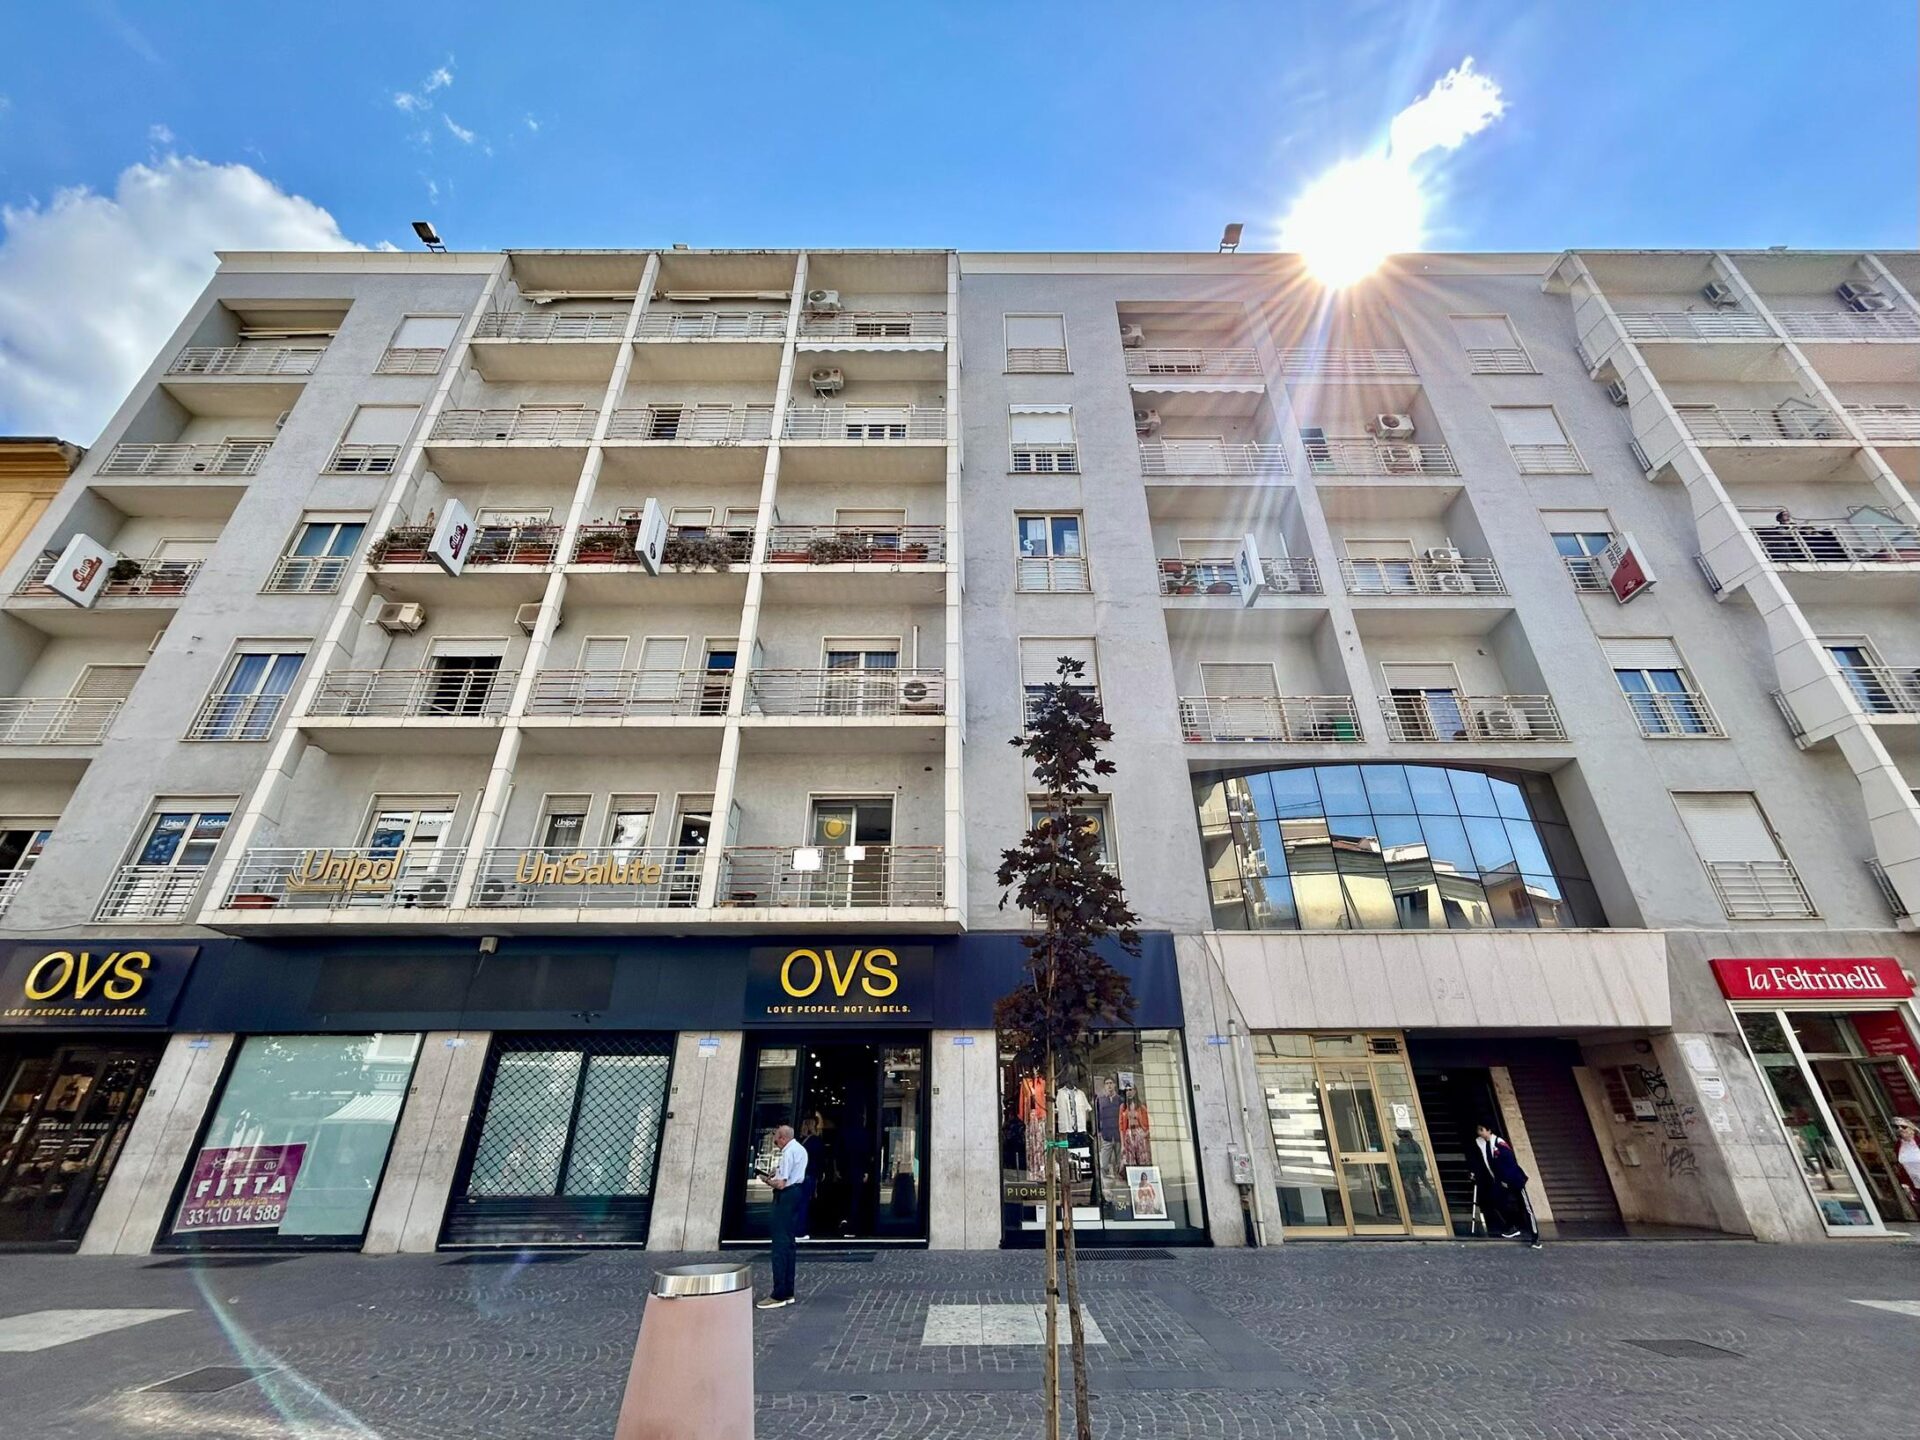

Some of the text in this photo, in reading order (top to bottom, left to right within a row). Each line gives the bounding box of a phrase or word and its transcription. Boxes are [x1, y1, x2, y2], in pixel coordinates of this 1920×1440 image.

[1605, 547, 1617, 569] SCUOLA
[162, 819, 186, 827] Unipol
[556, 817, 577, 827] Unipol
[302, 849, 404, 891] Unipol
[515, 851, 662, 885] UniSalute
[24, 950, 151, 1000] OVS
[780, 948, 898, 998] OVS
[1745, 965, 1887, 990] la Feltrinelli
[34, 1008, 77, 1016] PEOPLE.
[80, 1008, 102, 1016] NOT
[104, 1008, 148, 1016] LABELS.
[868, 1005, 911, 1013] LABELS.
[195, 1175, 287, 1198] FITTA
[1007, 1186, 1047, 1197] PIOMB
[186, 1204, 280, 1225] 331.10 14 588
